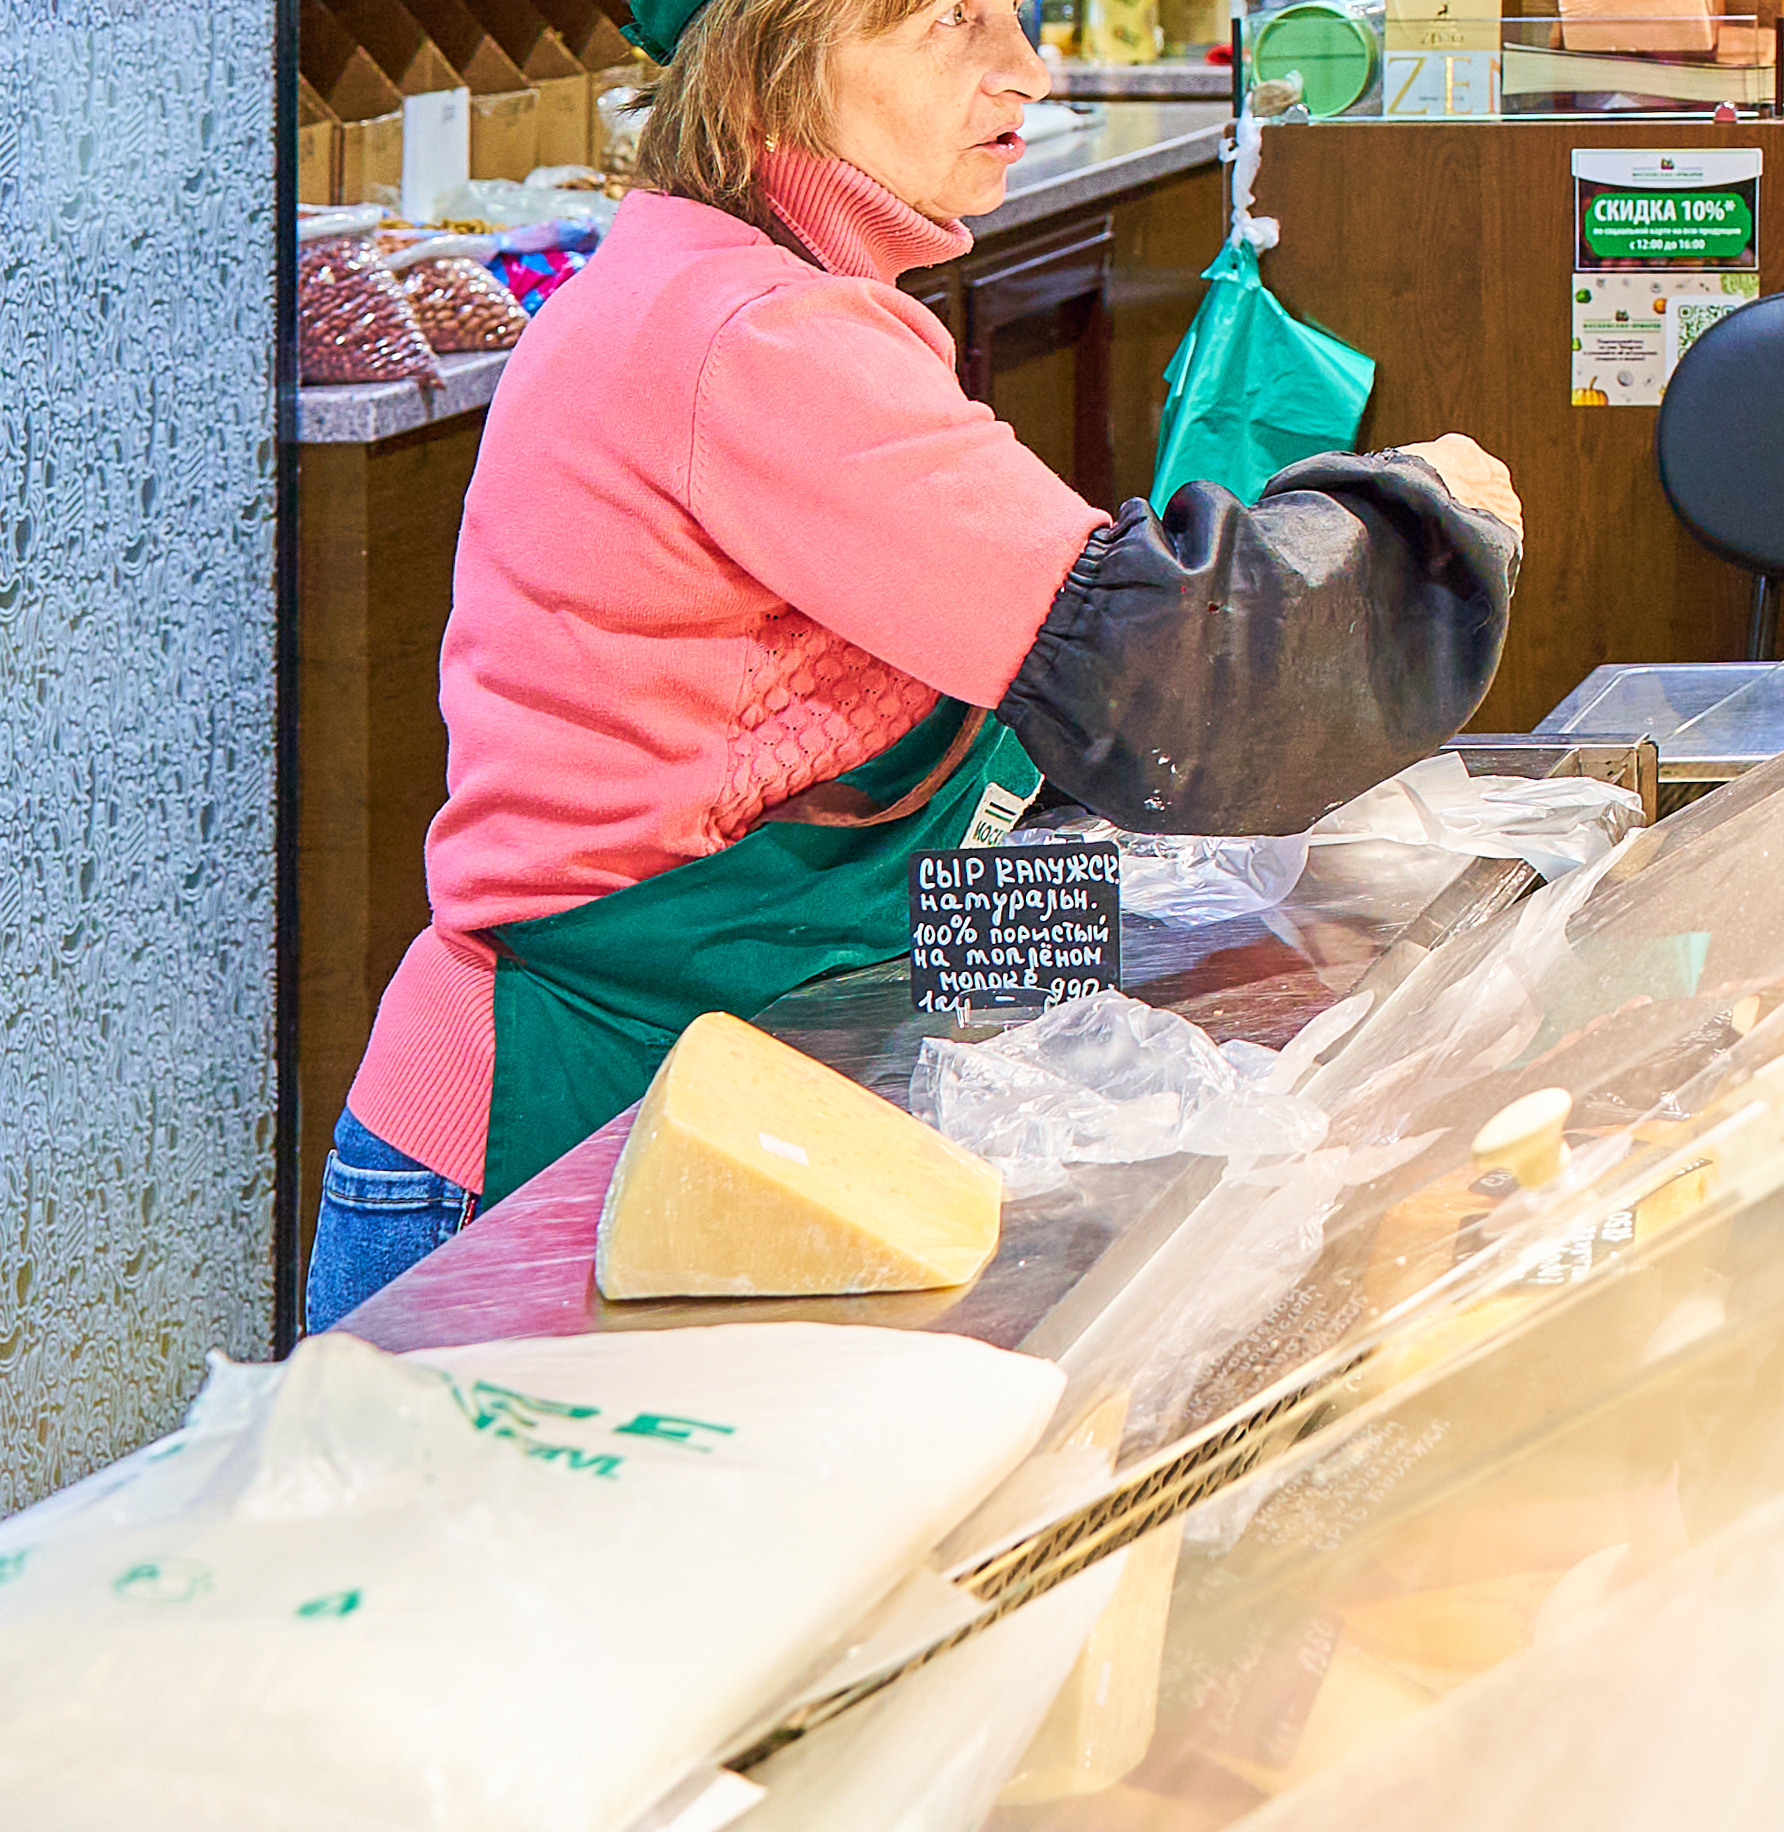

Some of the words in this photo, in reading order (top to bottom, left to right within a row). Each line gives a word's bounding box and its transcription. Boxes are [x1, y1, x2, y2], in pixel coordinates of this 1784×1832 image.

[1594, 198, 1677, 225] СКИДКА
[919, 856, 985, 890] СЫР
[913, 914, 978, 946] 100%
[989, 914, 1110, 944] пористый
[914, 947, 951, 969] на
